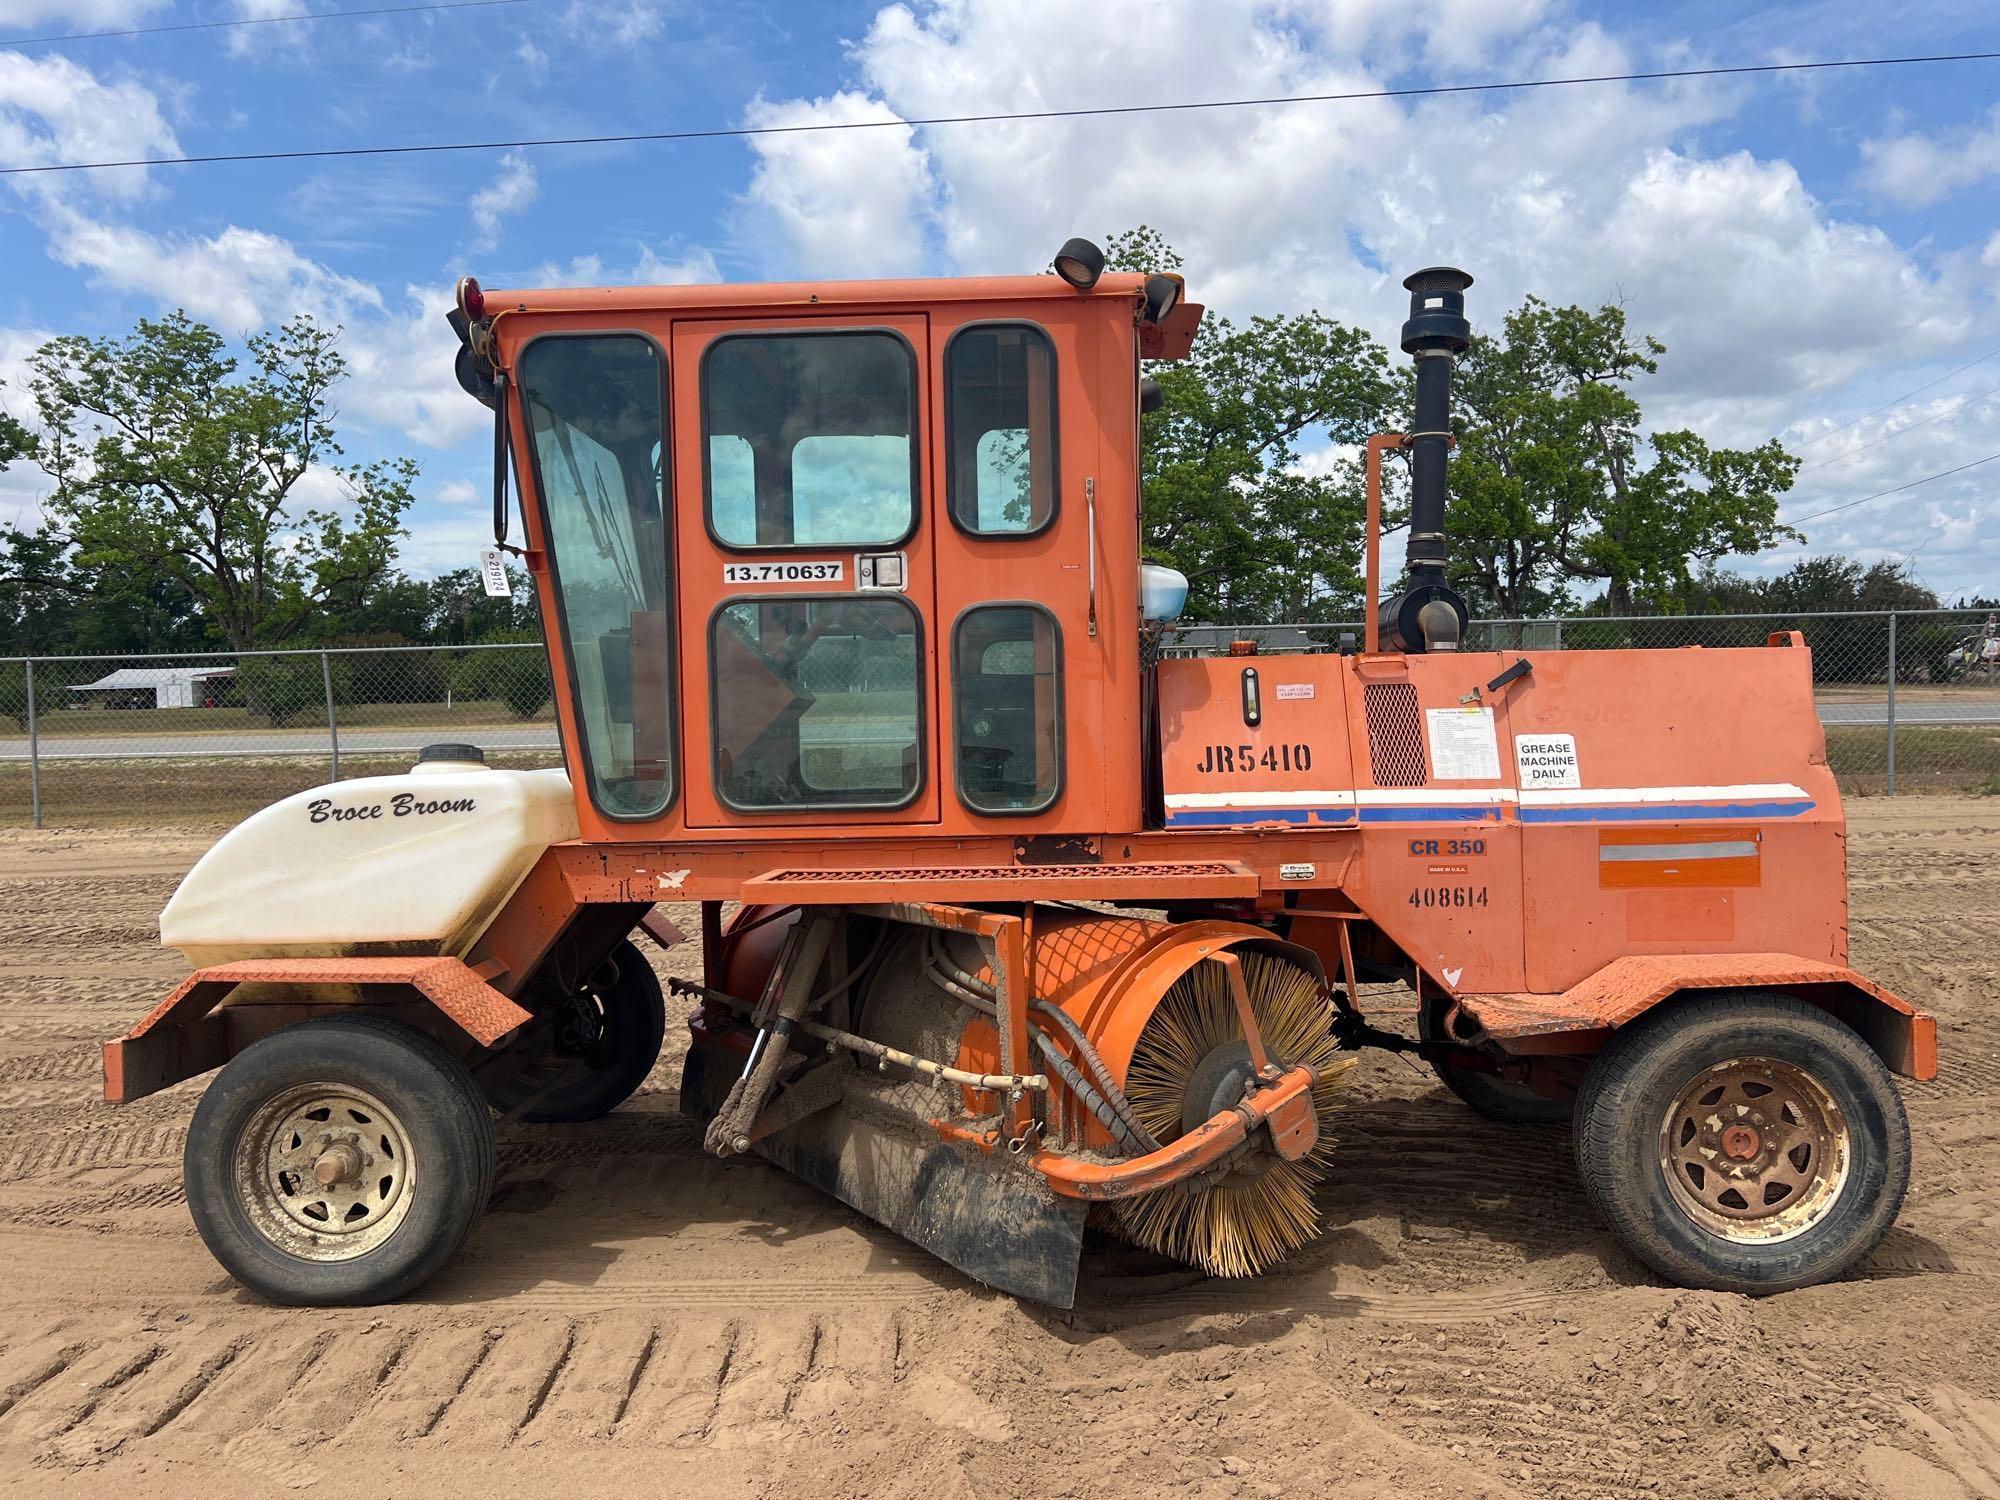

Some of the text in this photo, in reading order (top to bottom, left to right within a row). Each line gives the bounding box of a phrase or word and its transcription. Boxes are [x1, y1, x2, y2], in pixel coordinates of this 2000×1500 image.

[490, 561, 504, 591] 219124
[726, 565, 840, 581] 13.710637
[1521, 744, 1571, 753] GREASE
[1197, 744, 1311, 773] JR5410
[1520, 756, 1575, 766] MACHINE
[1532, 769, 1566, 779] DAILY
[307, 792, 477, 824] Broce Broom
[1410, 839, 1485, 855] CR 350
[1408, 886, 1488, 908] 408614
